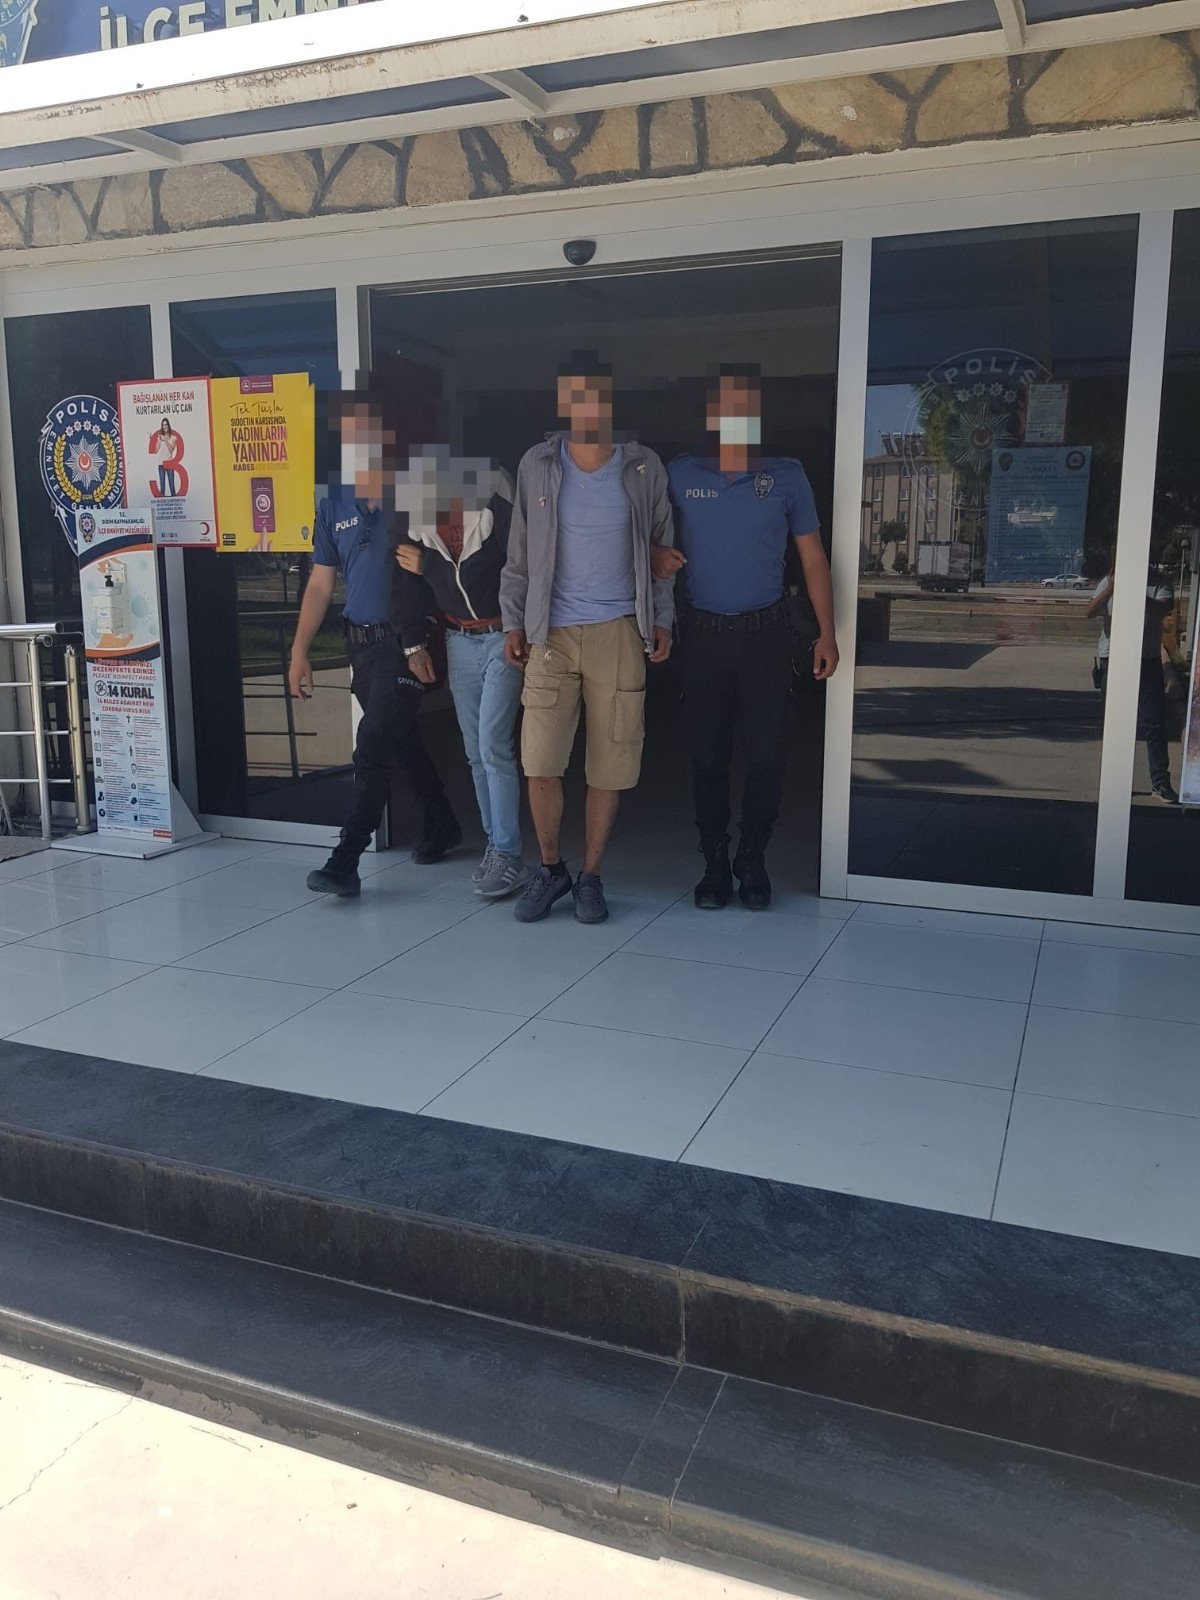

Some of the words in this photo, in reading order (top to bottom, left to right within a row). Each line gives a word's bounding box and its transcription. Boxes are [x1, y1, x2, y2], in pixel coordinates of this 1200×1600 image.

[132, 392, 168, 404] BAĞIŞLANAN
[169, 391, 182, 401] HER
[182, 390, 195, 401] KAN
[55, 400, 109, 424] POLİS
[135, 404, 171, 415] KURTARILAN
[171, 401, 180, 415] ÜÇ
[180, 403, 193, 413] CAN
[231, 425, 287, 442] KADINLARIN
[232, 441, 288, 463] YANINDA
[233, 463, 255, 472] KADES
[92, 666, 131, 674] DEZENFEKTE
[107, 684, 119, 697] 14
[120, 686, 155, 700] KURAL
